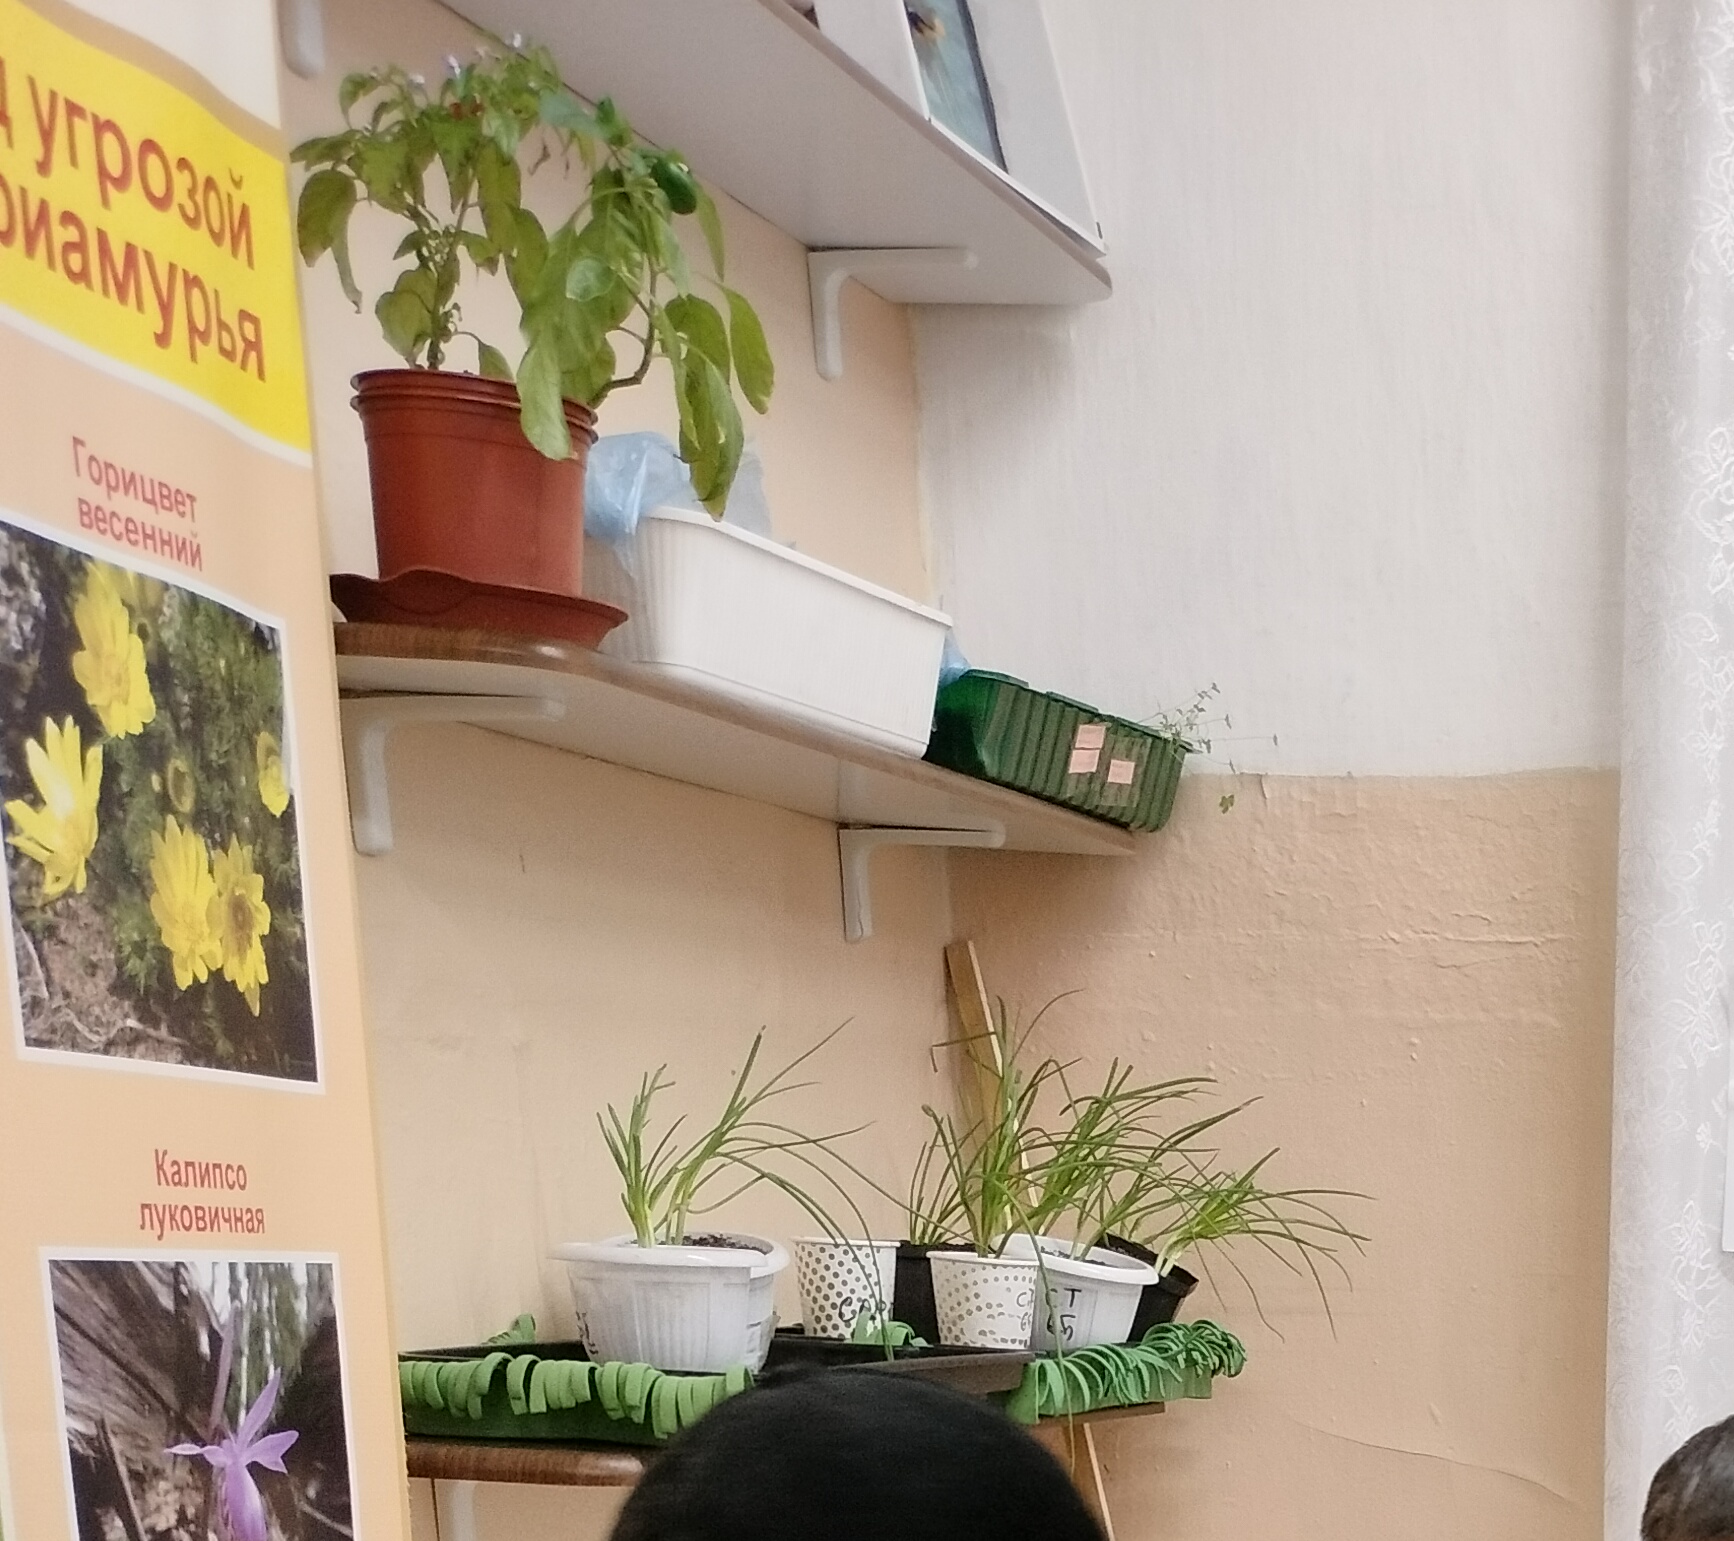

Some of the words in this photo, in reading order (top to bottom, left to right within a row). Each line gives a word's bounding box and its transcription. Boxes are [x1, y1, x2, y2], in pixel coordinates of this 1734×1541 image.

[27, 74, 255, 270] угрозой
[72, 436, 197, 523] Горицвет
[78, 497, 202, 572] весенний
[154, 1149, 247, 1191] Калипсо
[140, 1203, 266, 1241] луковичная
